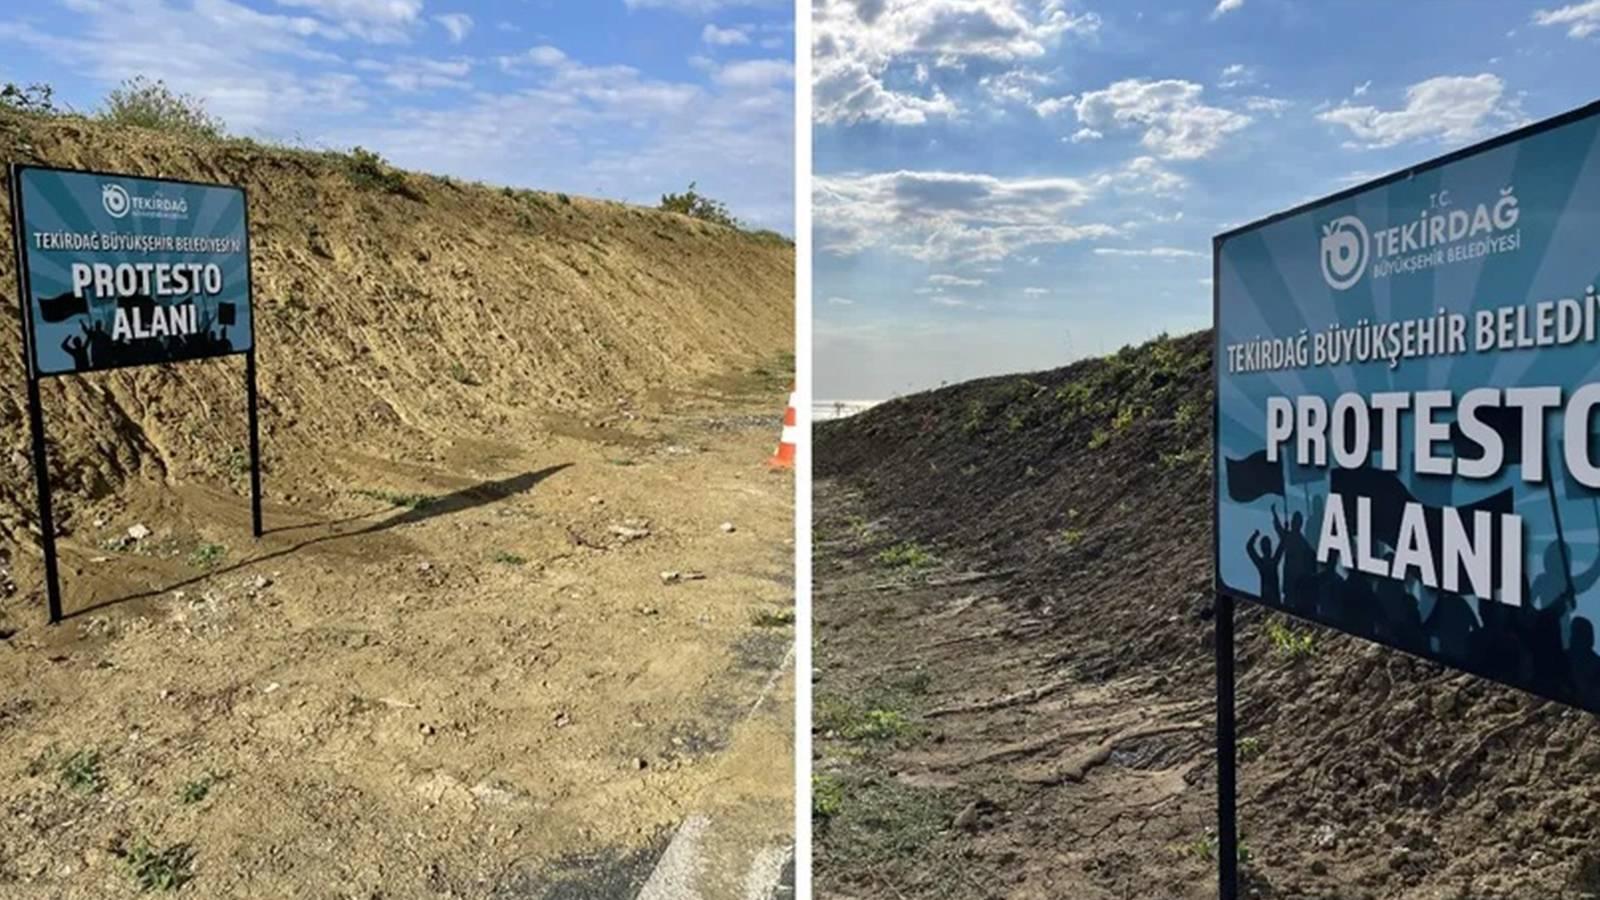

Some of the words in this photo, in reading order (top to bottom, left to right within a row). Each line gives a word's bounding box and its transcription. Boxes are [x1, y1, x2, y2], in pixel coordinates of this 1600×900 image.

[131, 195, 188, 213] TEKİRDAĞ
[1373, 186, 1520, 258] TEKİRDAĞ
[33, 229, 99, 251] TEKİRDAĞ
[102, 231, 174, 255] BÜYÜKŞEHİR
[1372, 251, 1444, 280] BÜYÜKŞEHİR
[1447, 228, 1521, 264] BELEDİYESİ
[71, 262, 223, 298] PROTESTO
[111, 303, 199, 342] ALANI
[1227, 328, 1308, 374] TEKİRDAĞ
[1315, 307, 1468, 369] BÜYÜKŞEHİR
[1475, 284, 1600, 352] BELEDİ
[1317, 493, 1523, 608] ALANI
